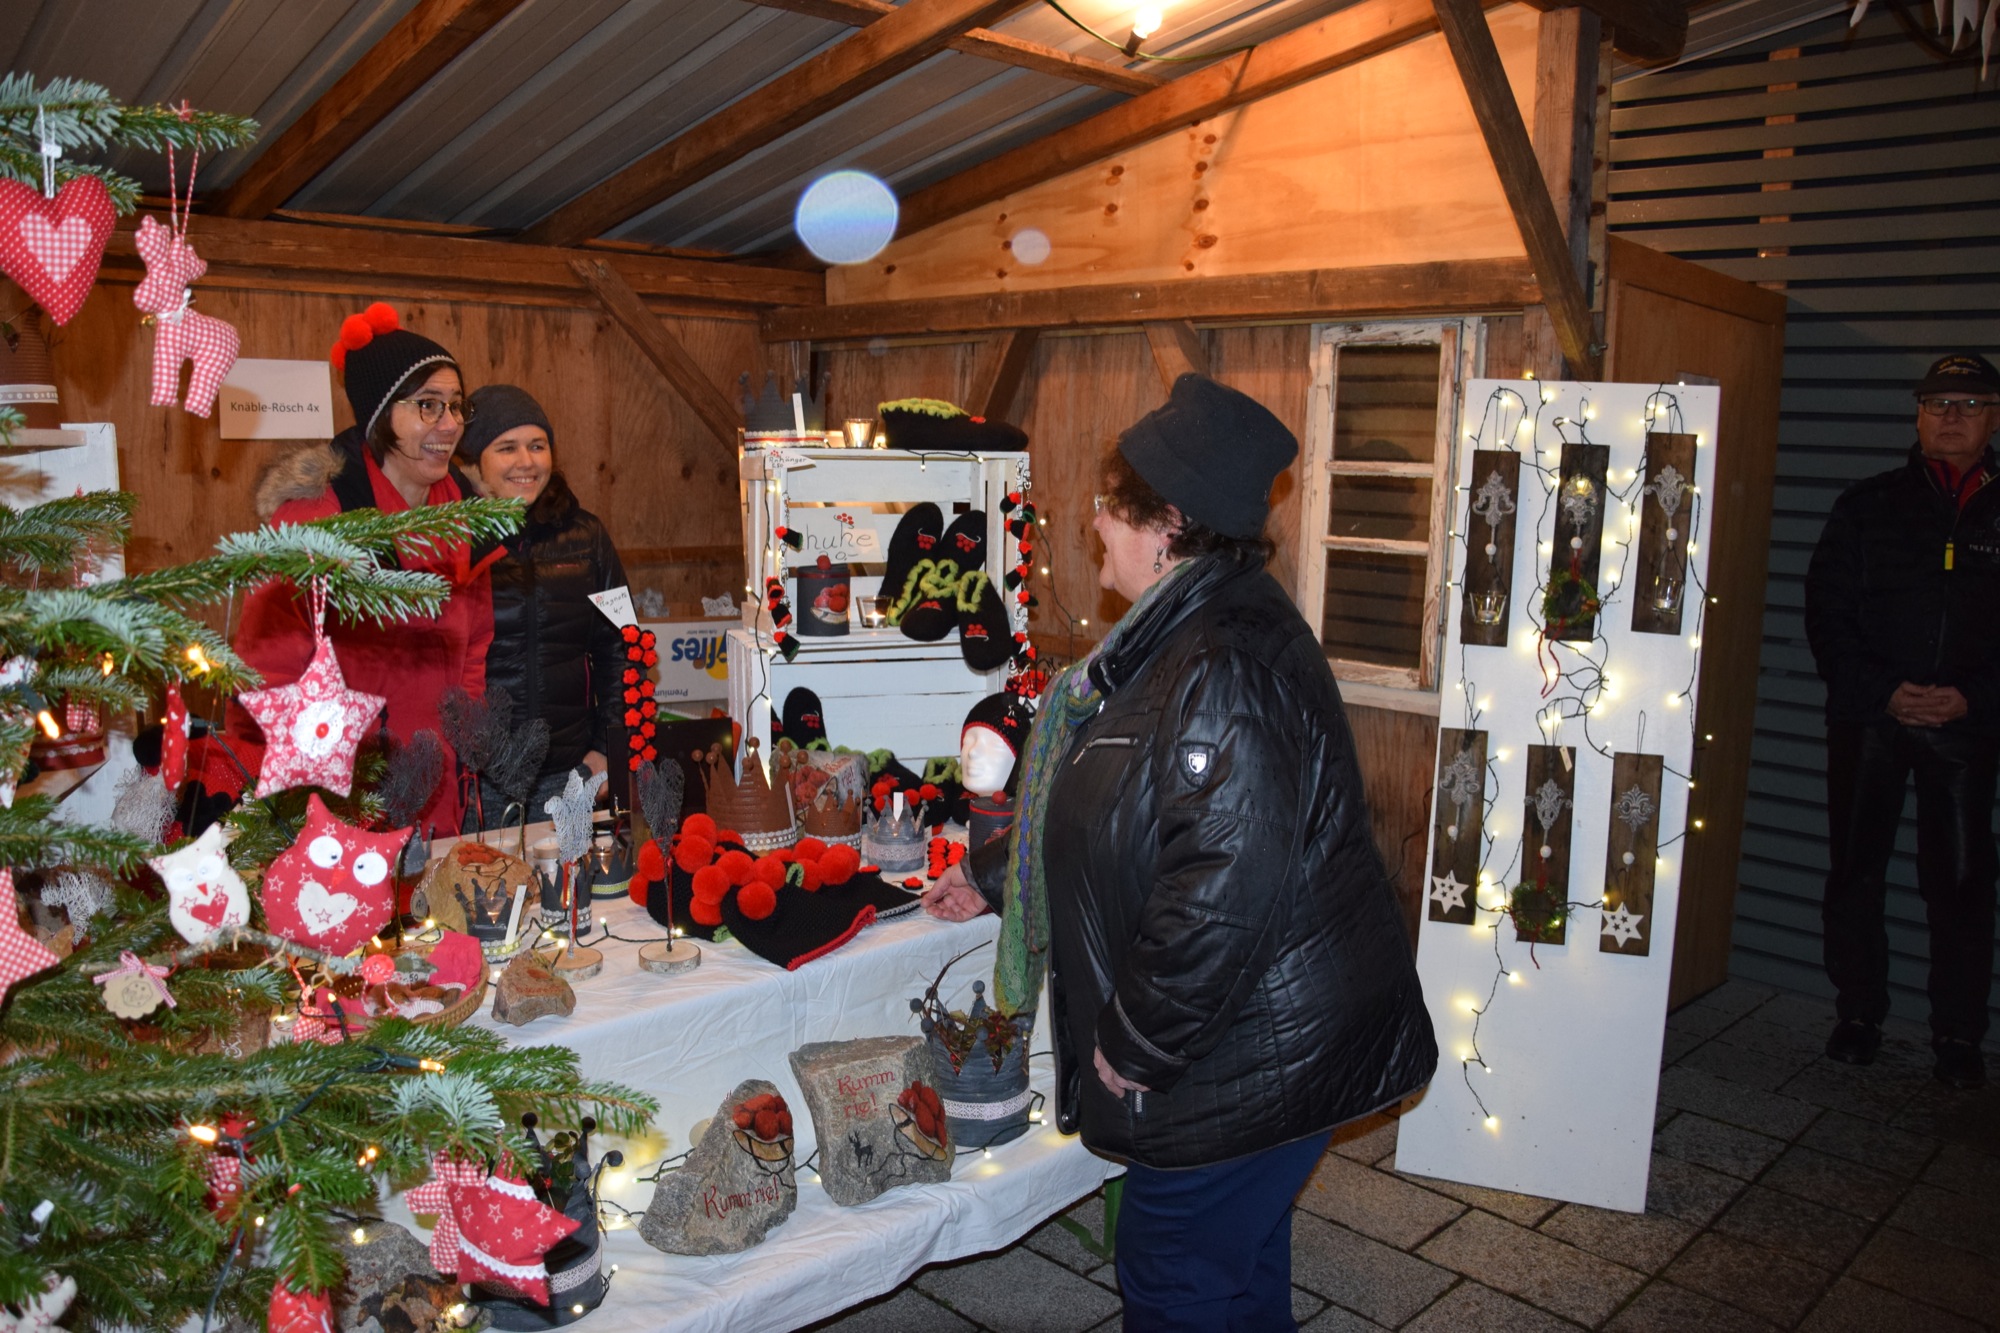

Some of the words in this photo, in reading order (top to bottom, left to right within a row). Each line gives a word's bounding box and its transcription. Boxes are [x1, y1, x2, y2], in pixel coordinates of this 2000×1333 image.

[230, 402, 304, 413] Knäble-Rösch
[307, 403, 320, 413] 4x
[806, 520, 873, 550] huhe
[837, 1071, 895, 1096] Kumm
[703, 1185, 752, 1219] Kumm
